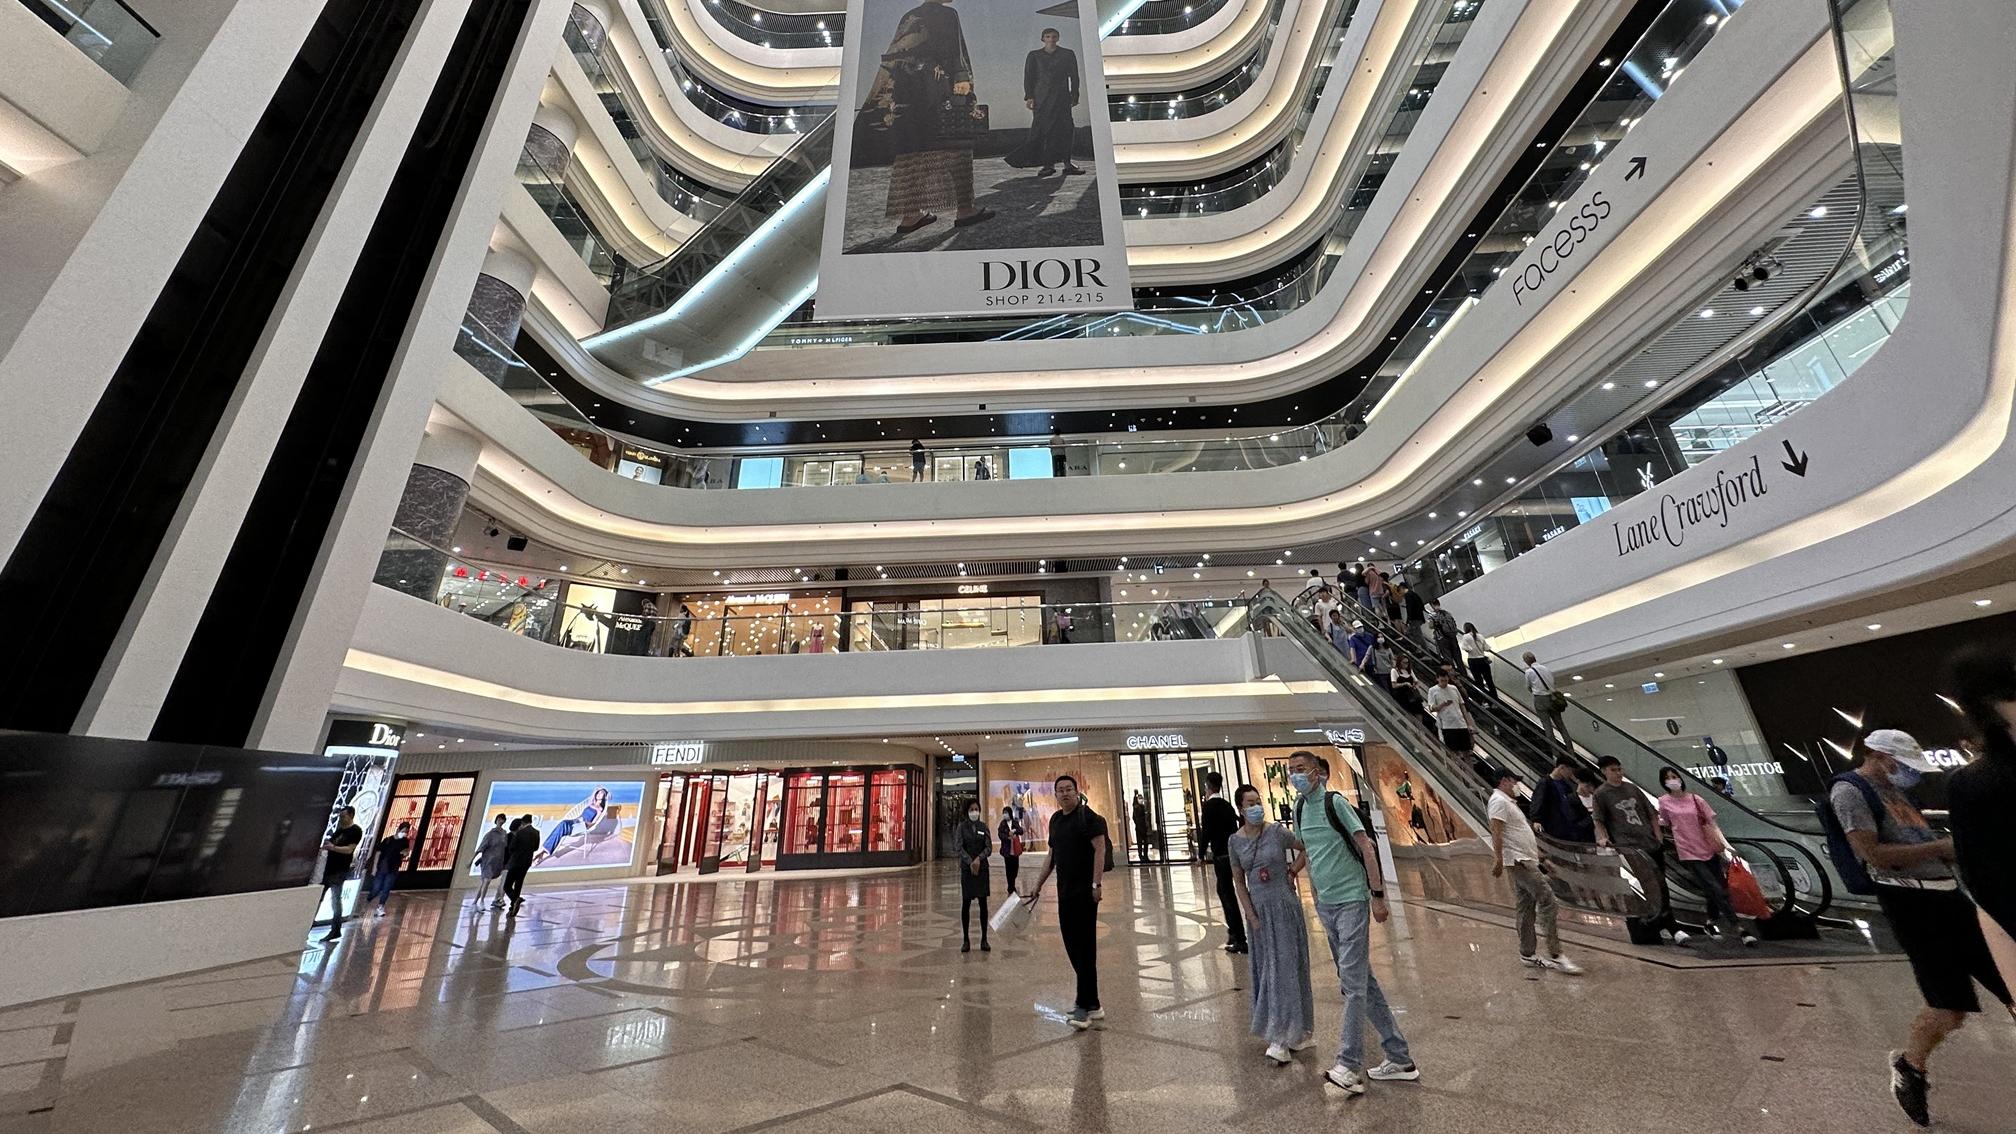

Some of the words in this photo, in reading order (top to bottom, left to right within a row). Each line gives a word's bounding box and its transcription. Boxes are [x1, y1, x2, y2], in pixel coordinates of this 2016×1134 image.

[977, 258, 1109, 291] DIOR
[986, 295, 1029, 306] SHOP
[1037, 292, 1104, 304] 214-215
[1613, 514, 1660, 557] Lane
[1660, 454, 1768, 547] Crawford
[1542, 526, 1565, 541] TASAKI
[368, 723, 401, 747] Dior
[1126, 734, 1188, 750] CHANEL
[654, 747, 701, 763] FENDI
